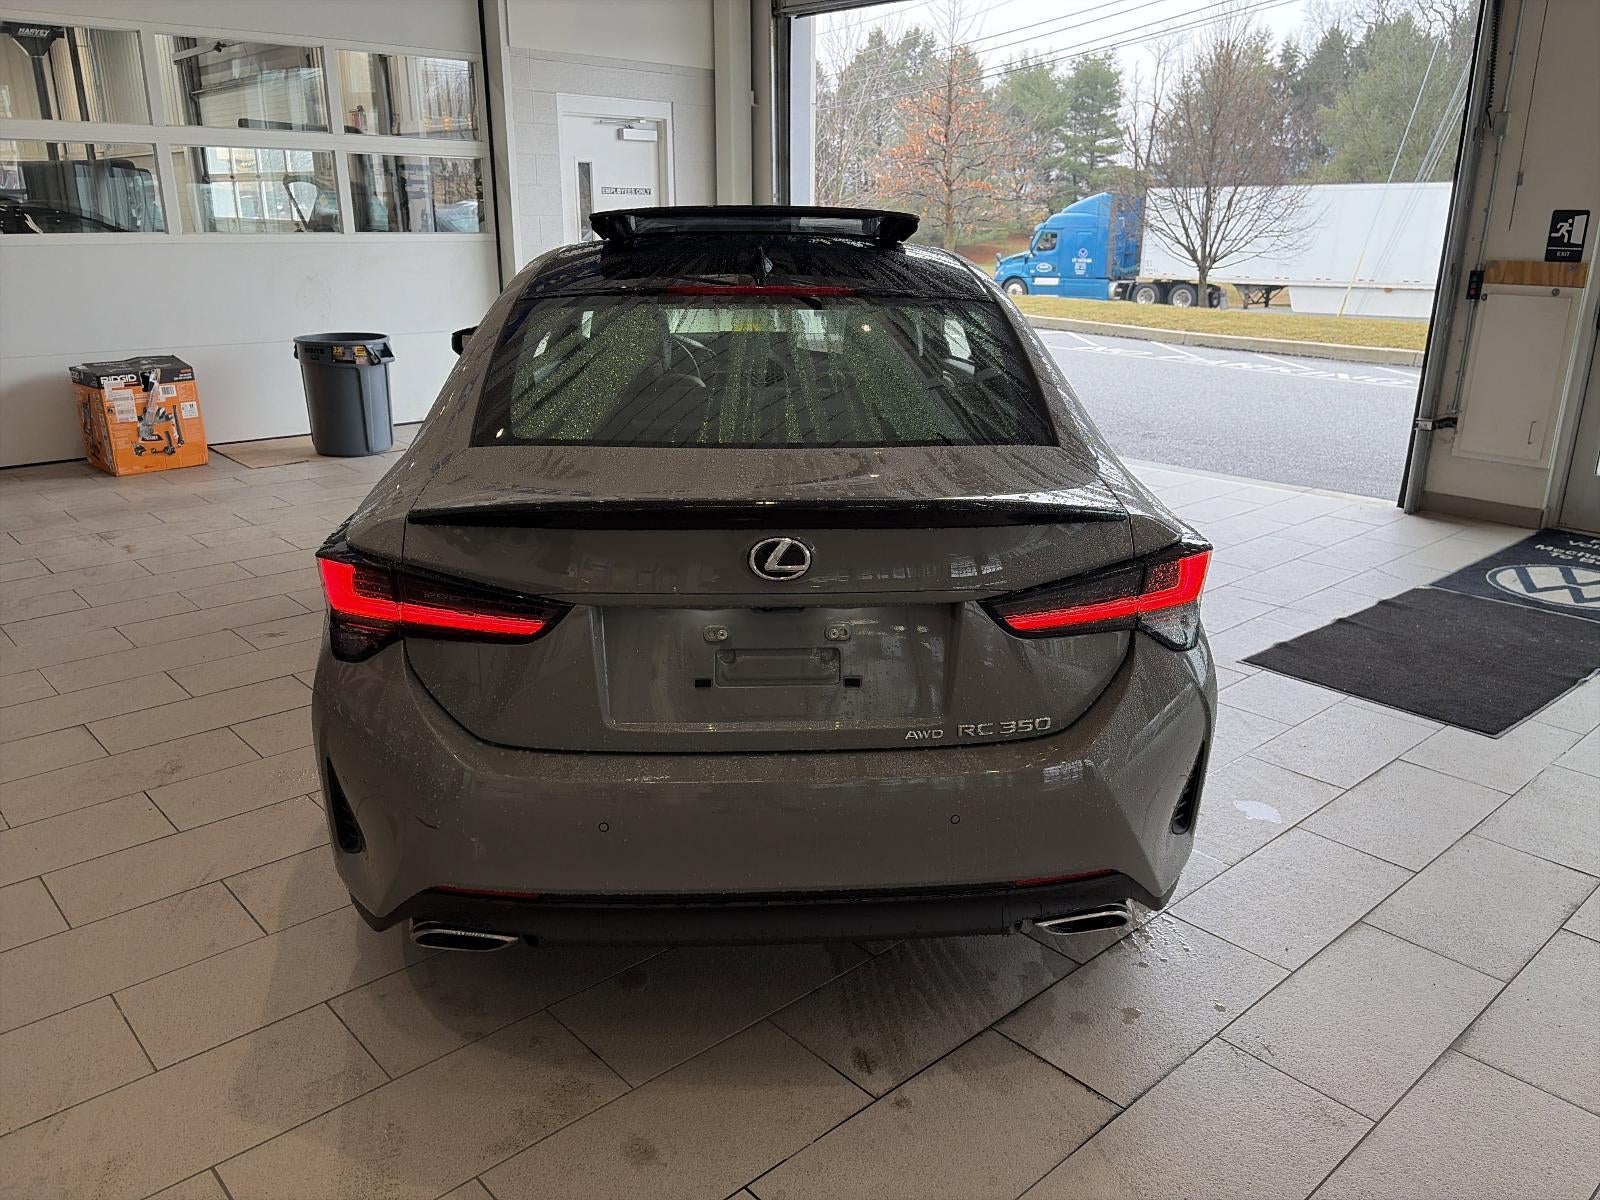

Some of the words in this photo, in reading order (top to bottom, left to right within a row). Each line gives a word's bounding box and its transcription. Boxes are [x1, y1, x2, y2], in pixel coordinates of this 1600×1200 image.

[602, 187, 635, 195] EMPLOYEES
[100, 374, 137, 385] RIDGID
[957, 722, 994, 737] RC
[999, 716, 1052, 735] 350
[904, 729, 944, 741] AWD
